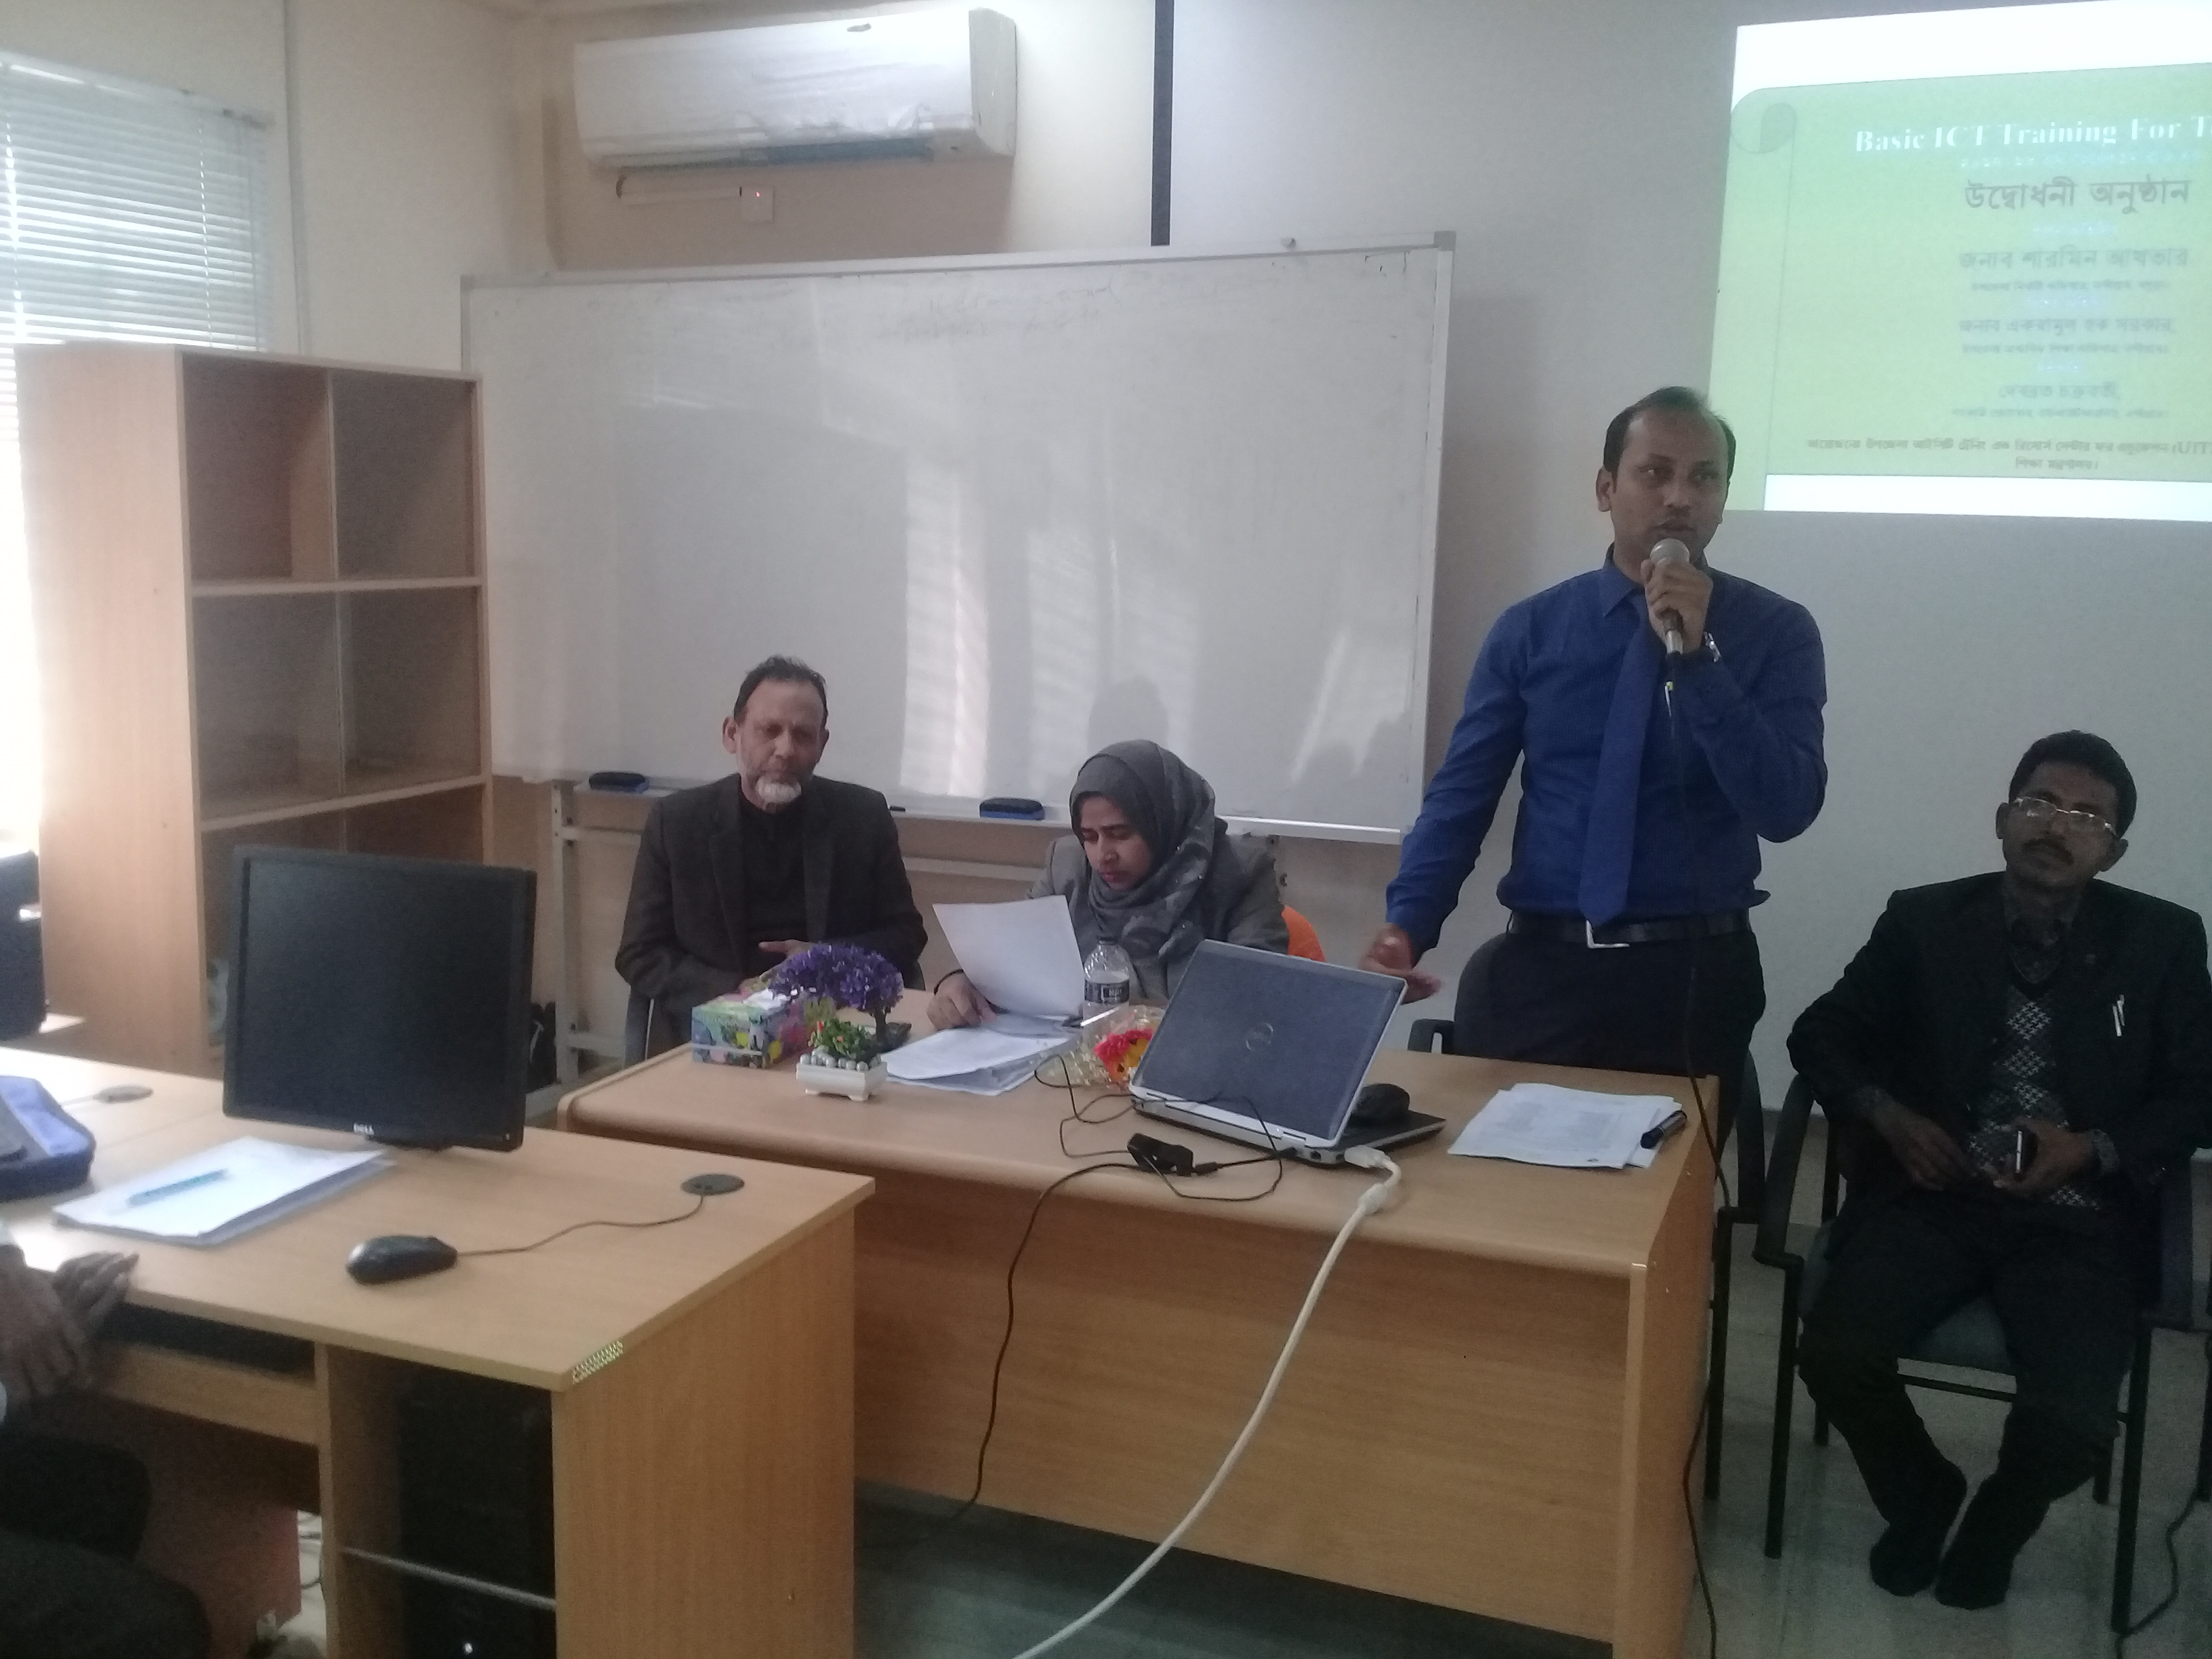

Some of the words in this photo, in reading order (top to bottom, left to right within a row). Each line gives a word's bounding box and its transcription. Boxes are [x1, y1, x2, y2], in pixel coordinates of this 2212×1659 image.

[1856, 128, 1925, 152] Basic
[1935, 124, 1990, 148] ICT
[1998, 121, 2116, 147] Training
[2131, 117, 2182, 140] For
[1965, 176, 2077, 210] উদ্বোধনী
[2090, 173, 2191, 214] অনুষ্ঠান
[1959, 251, 2013, 269] জনাব
